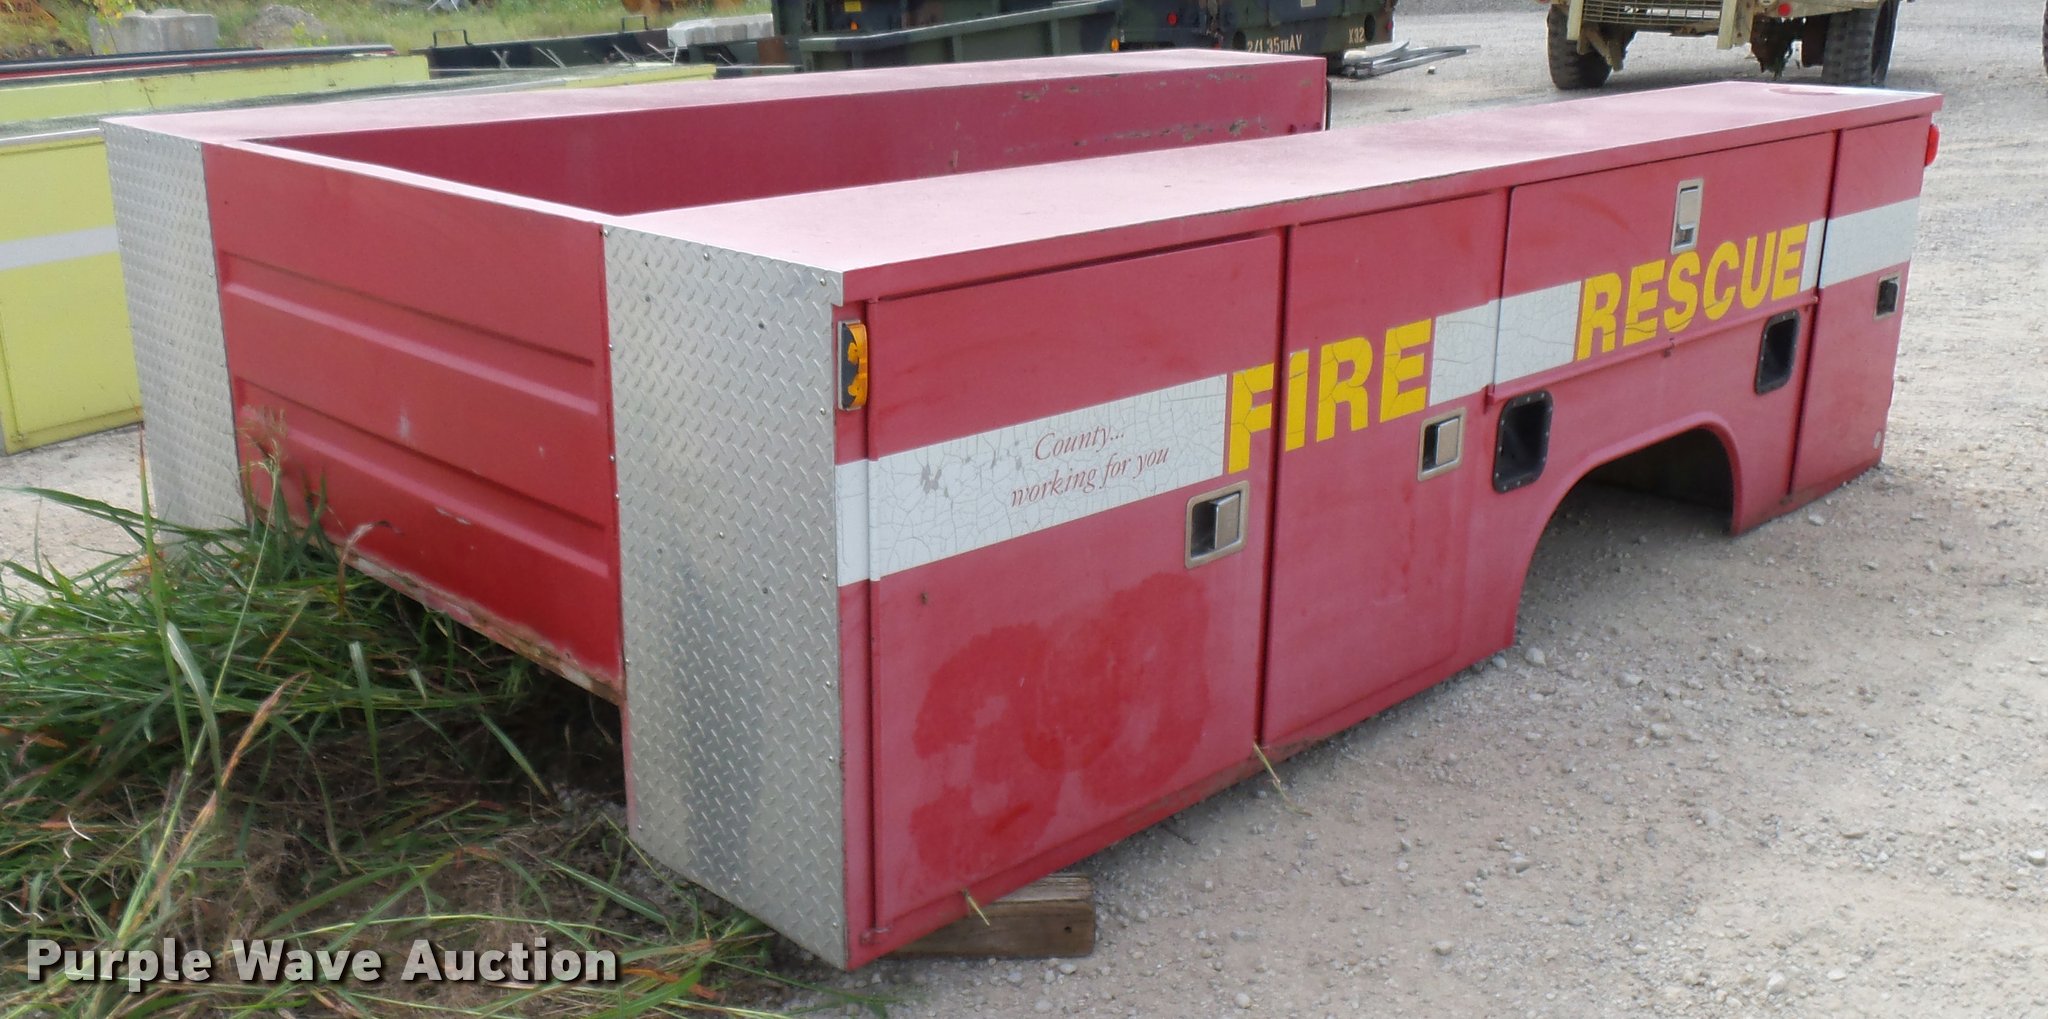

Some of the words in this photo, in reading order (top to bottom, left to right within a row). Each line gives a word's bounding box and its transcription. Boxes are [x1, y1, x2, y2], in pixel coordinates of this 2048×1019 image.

[1228, 318, 1432, 475] FIRE
[1577, 223, 1807, 362] RESCUE
[1035, 425, 1124, 461] County...
[1012, 468, 1097, 507] working
[1099, 452, 1132, 489] for
[1133, 447, 1169, 480] you
